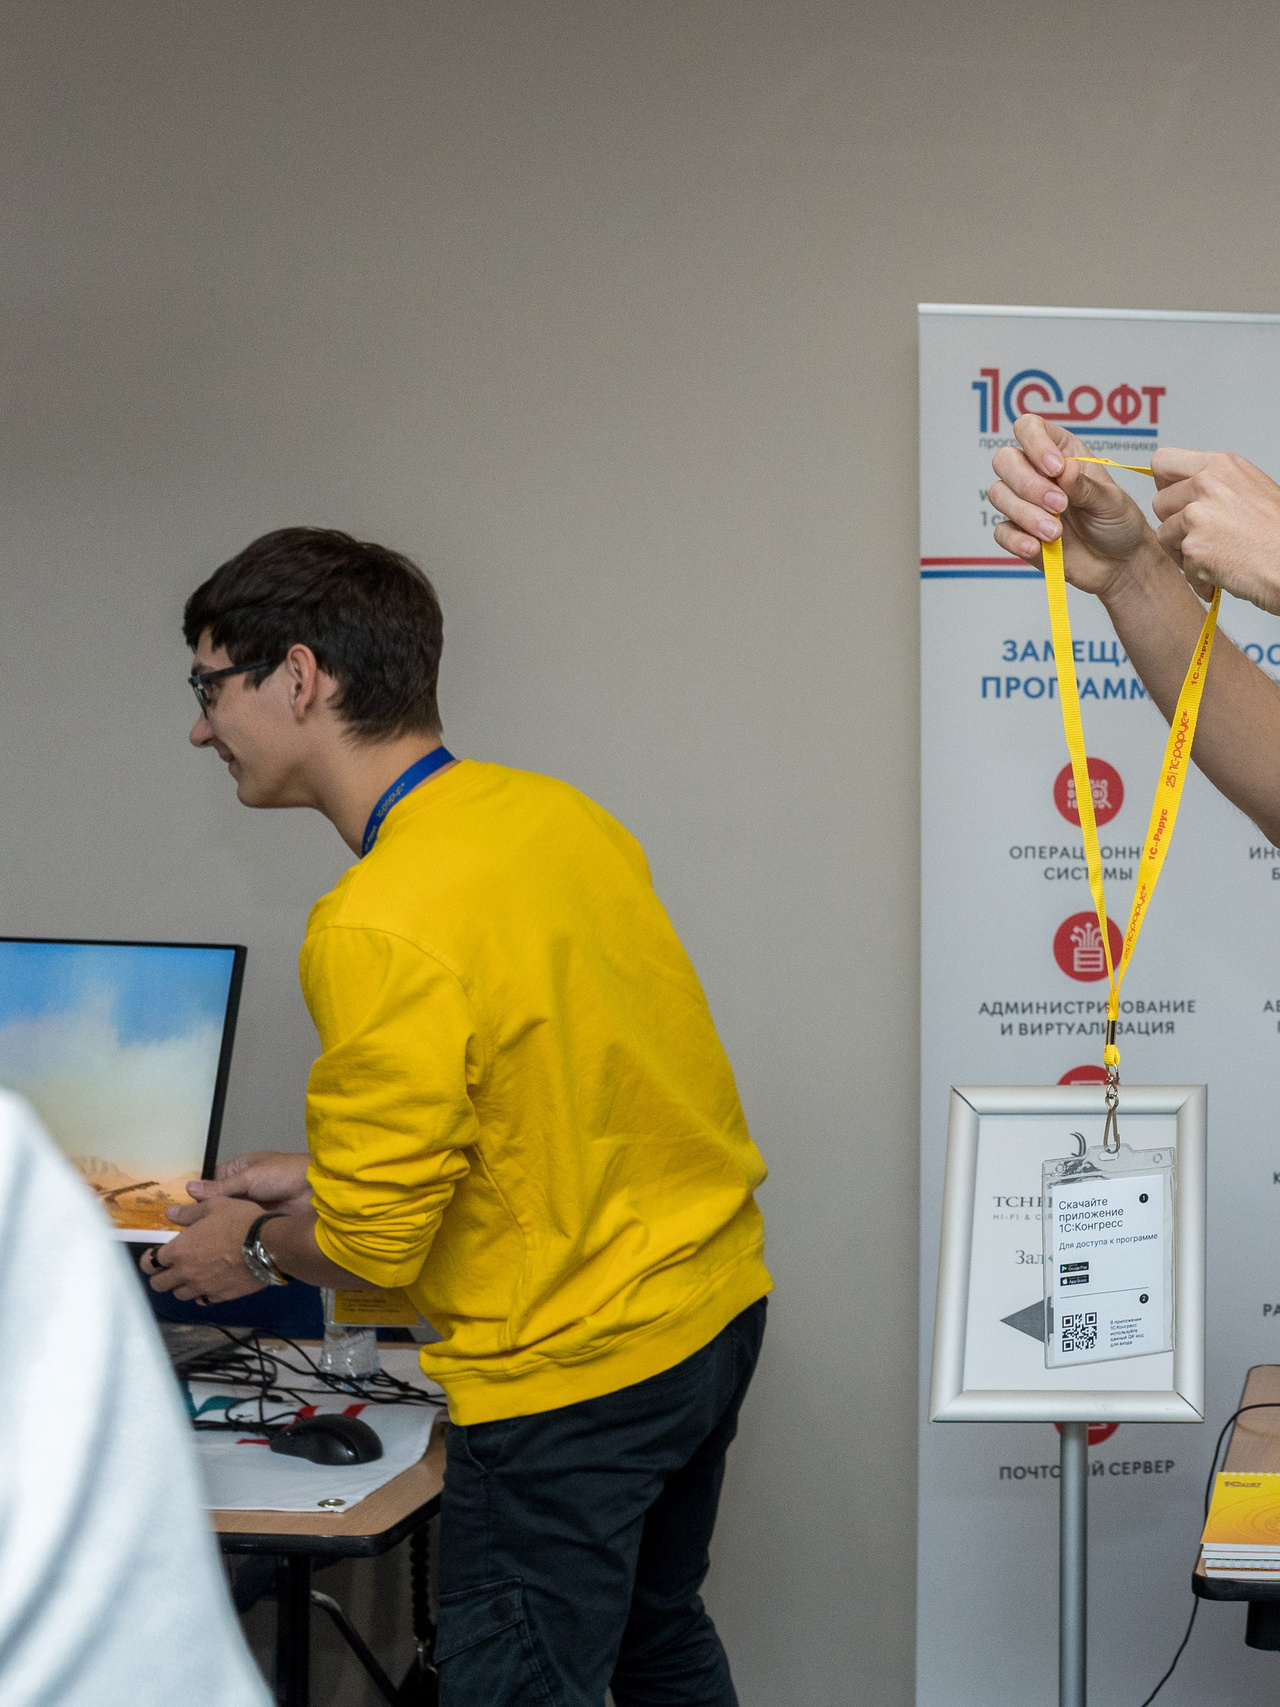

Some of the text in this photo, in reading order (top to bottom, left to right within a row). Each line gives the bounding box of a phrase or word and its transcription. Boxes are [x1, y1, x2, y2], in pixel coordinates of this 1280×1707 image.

[1043, 867, 1133, 881] СИСТМЫ
[978, 1000, 1196, 1016] АДМИНИСТРИОВАНИЕ
[1000, 1022, 1014, 1036] И
[1058, 1198, 1108, 1211] Скачайте
[1058, 1208, 1124, 1223] приложение
[1059, 1219, 1124, 1233] 1С:Конгресс
[1058, 1242, 1075, 1252] Для
[1076, 1238, 1108, 1250] доступа
[1115, 1233, 1158, 1246] программе
[1108, 1459, 1176, 1477] СЕРВЕР
